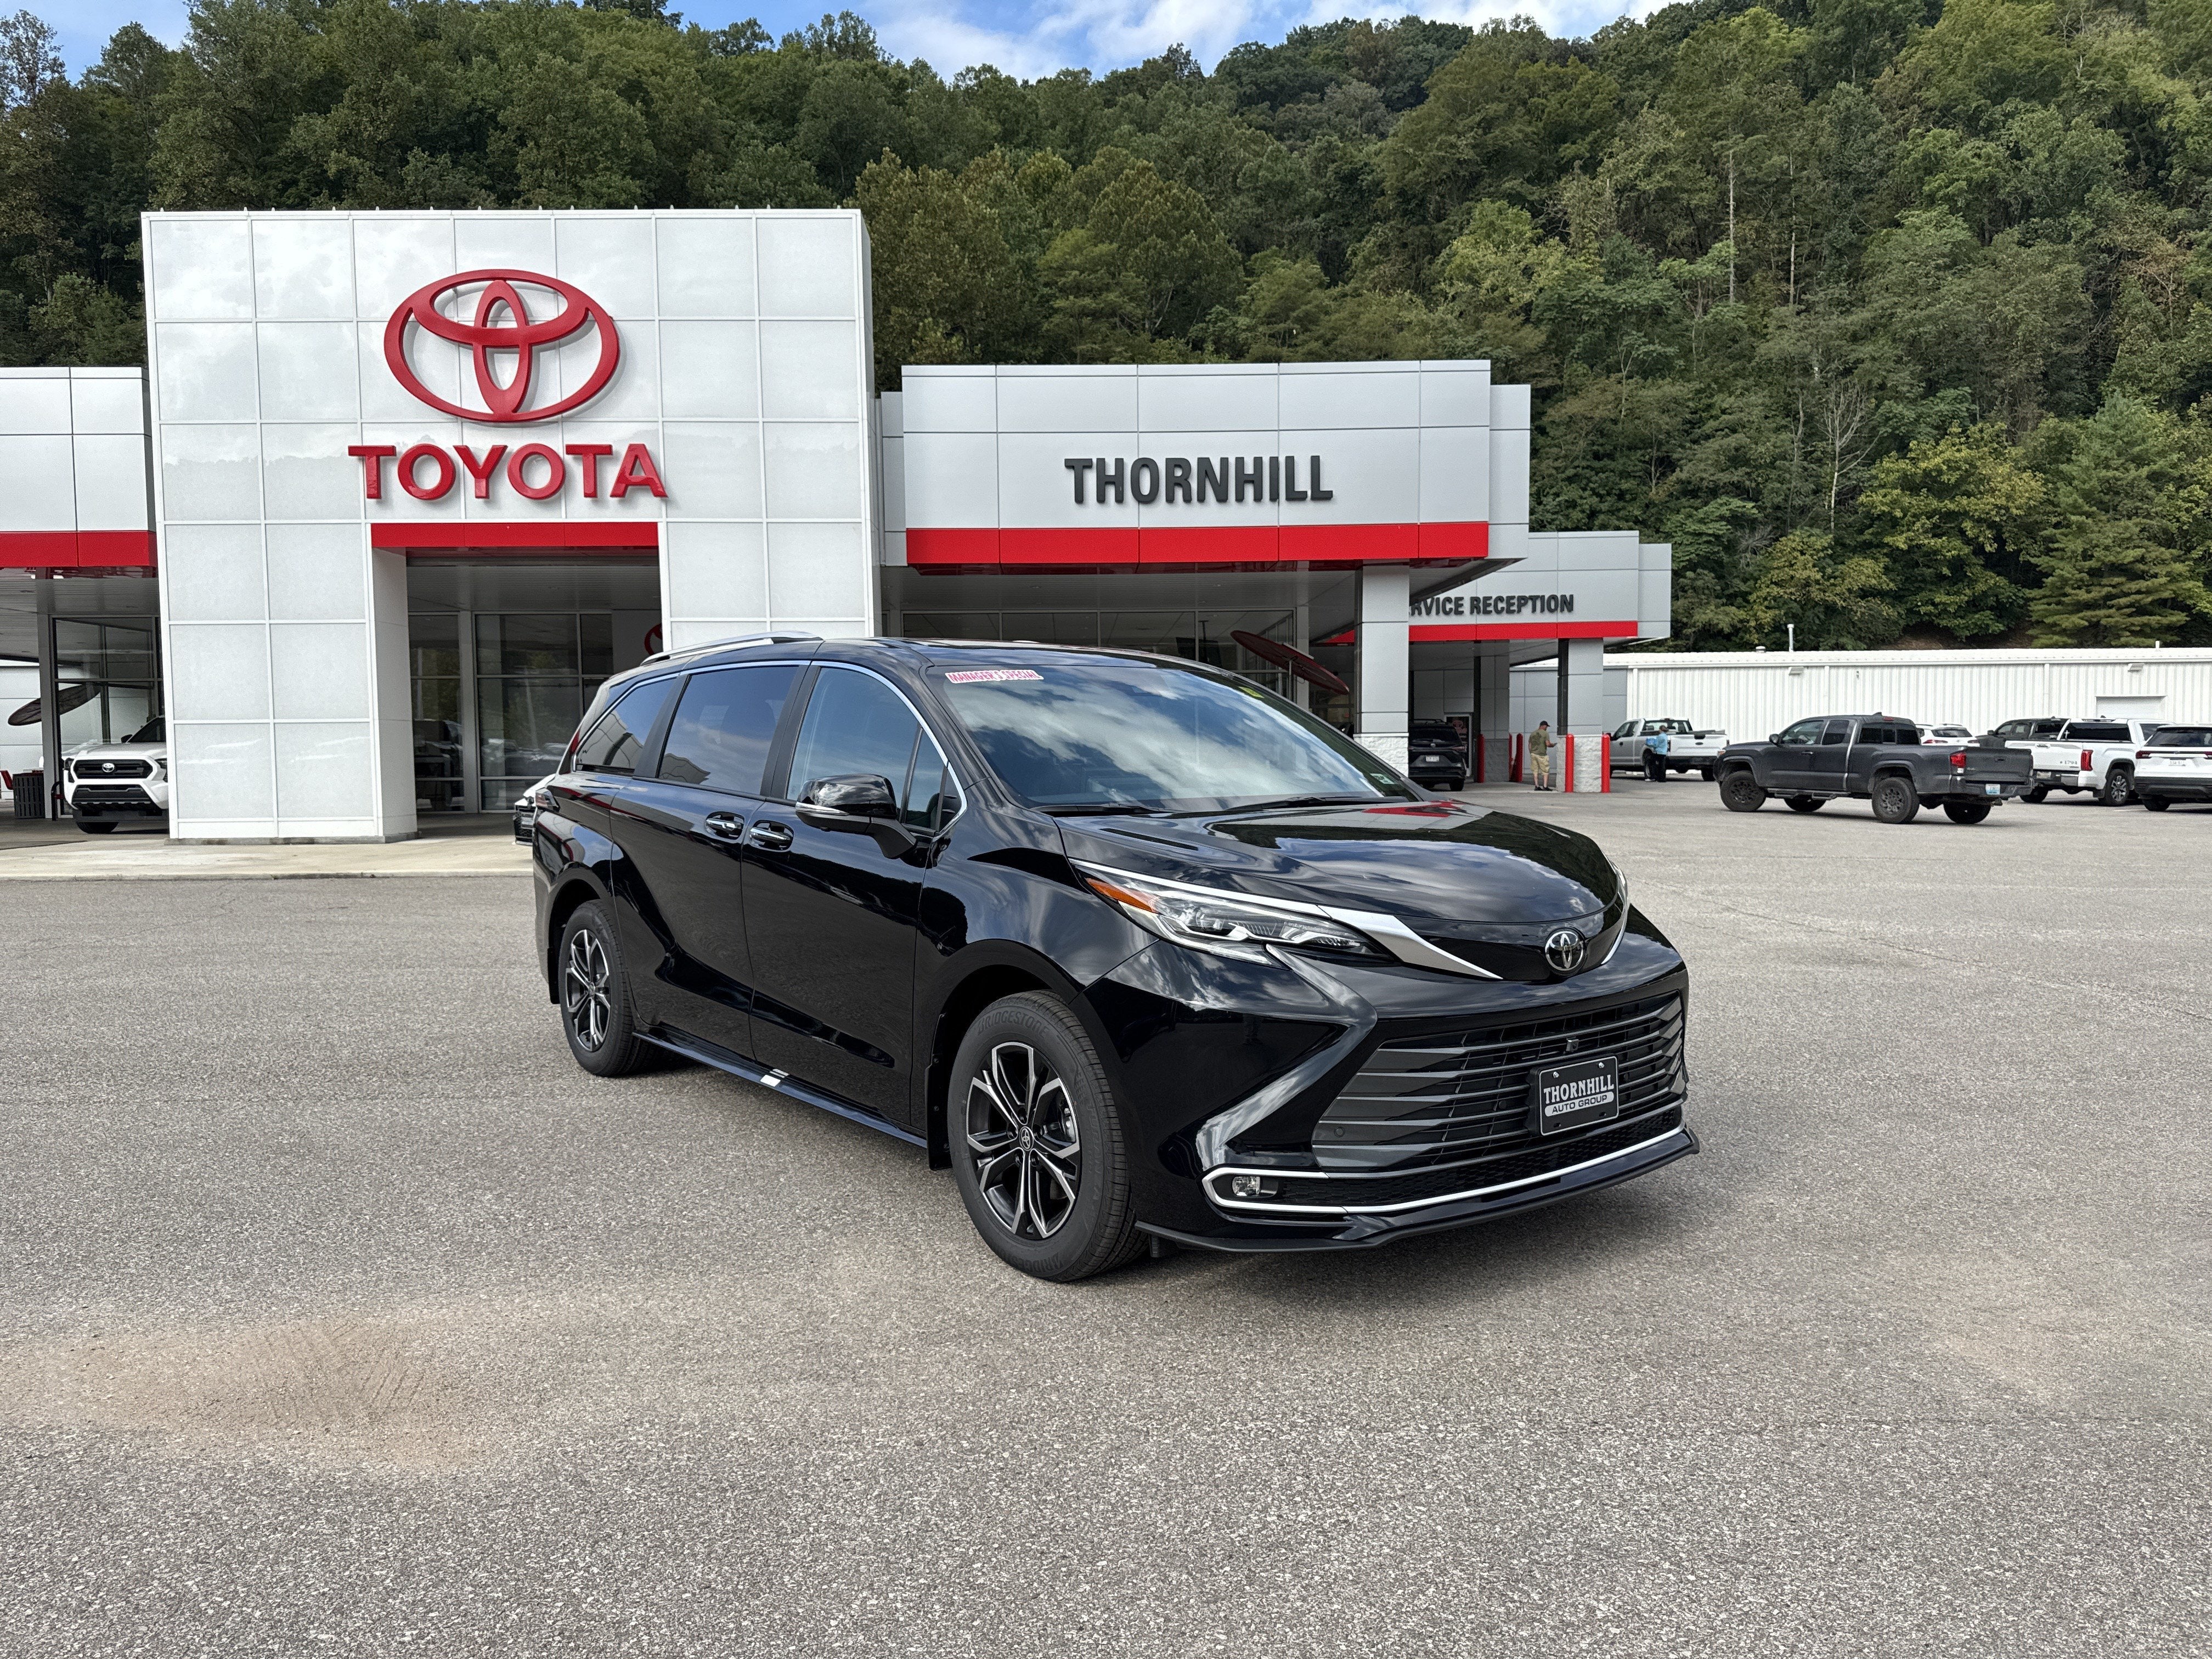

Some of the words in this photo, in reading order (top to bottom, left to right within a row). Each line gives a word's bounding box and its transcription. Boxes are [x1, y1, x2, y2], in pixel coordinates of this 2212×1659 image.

[348, 443, 668, 500] TOYOTA
[1064, 455, 1333, 504] THORNHILL
[1409, 596, 1464, 616] RVICE
[1469, 594, 1574, 615] RECEPTION
[1002, 670, 1042, 679] SPECIAL
[978, 1010, 1050, 1039] BRIDGESTONE
[1543, 1075, 1614, 1104] THORNHILL
[1552, 1102, 1575, 1114] AUTO
[1578, 1094, 1608, 1108] GROUP
